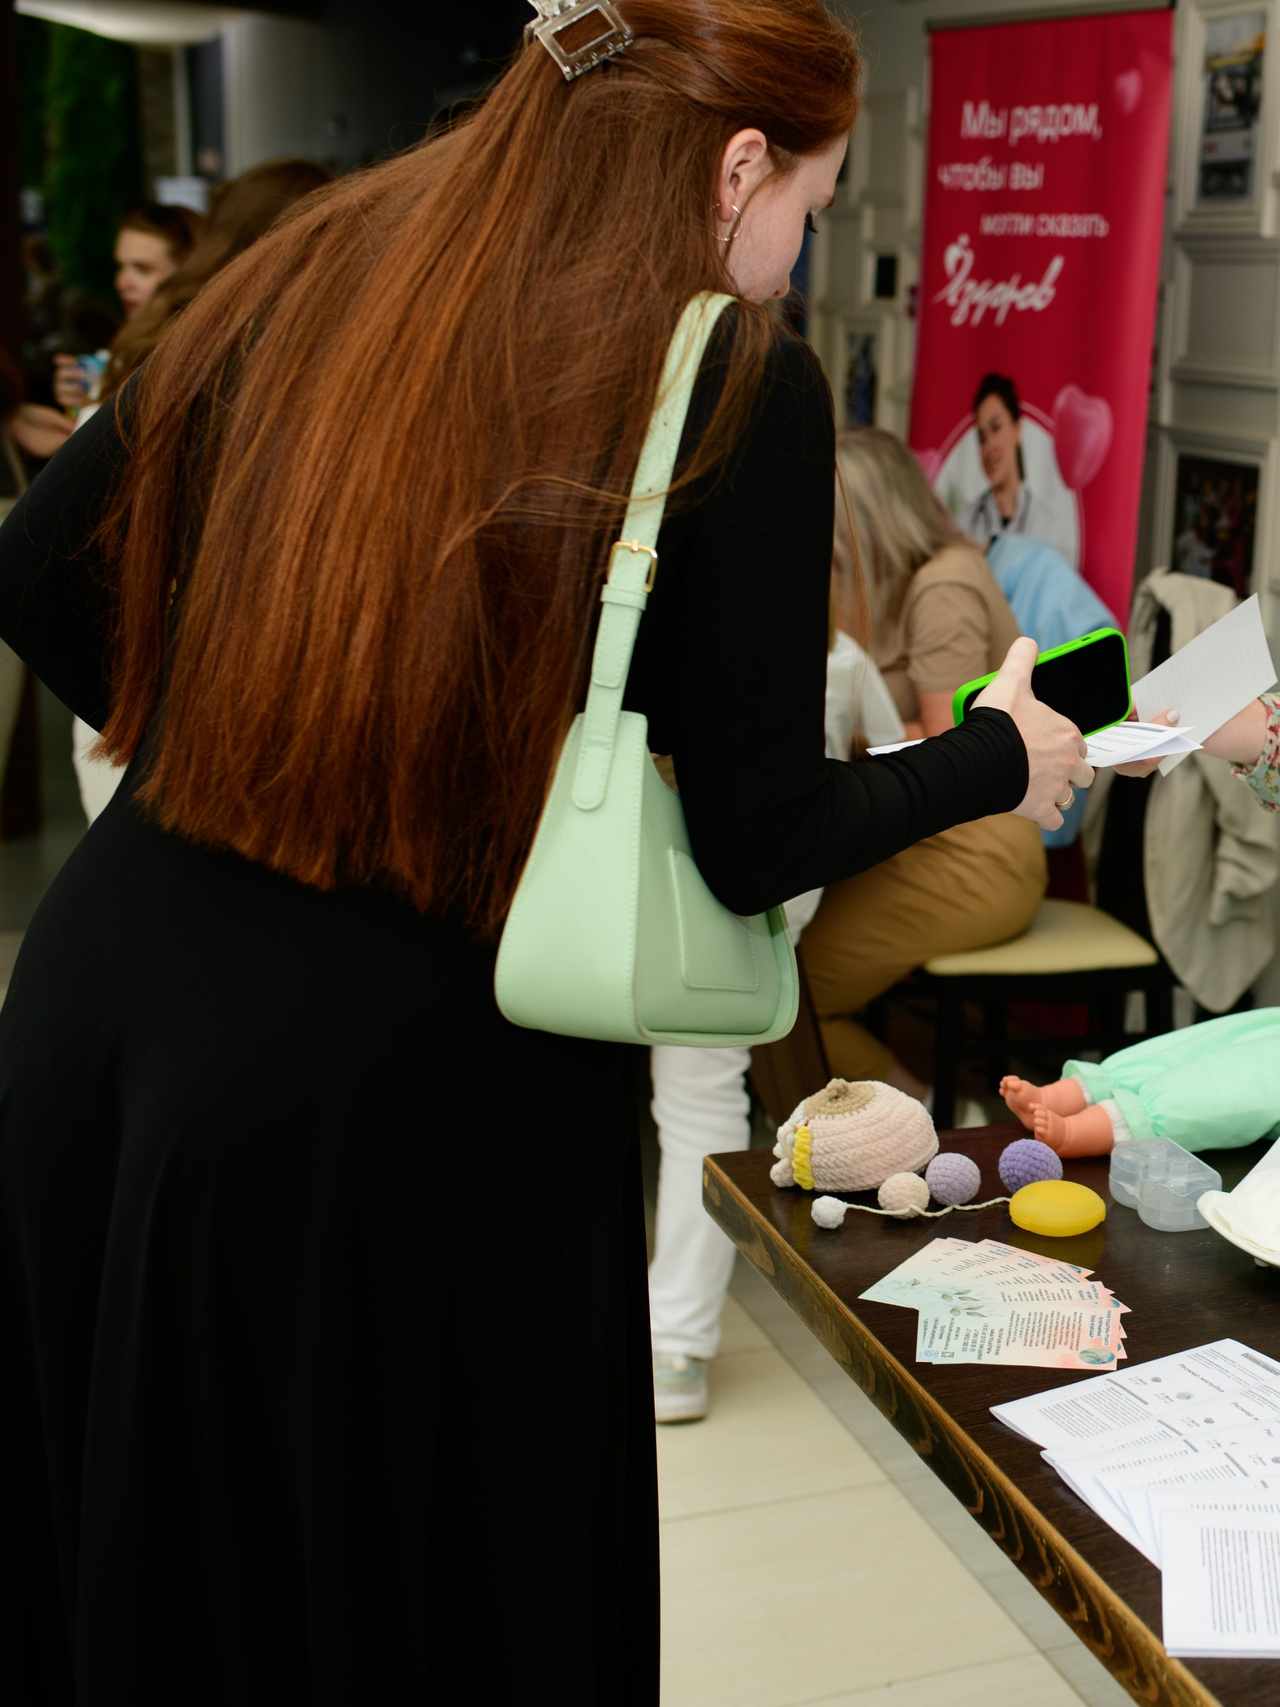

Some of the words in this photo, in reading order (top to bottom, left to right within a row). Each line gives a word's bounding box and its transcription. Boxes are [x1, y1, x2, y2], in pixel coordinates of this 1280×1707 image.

[961, 100, 1007, 138] Мы
[1009, 103, 1103, 147] рядом,
[937, 157, 1006, 191] чтобы
[1010, 163, 1044, 190] вы
[980, 213, 1034, 236] могли
[1036, 214, 1110, 237] сказать
